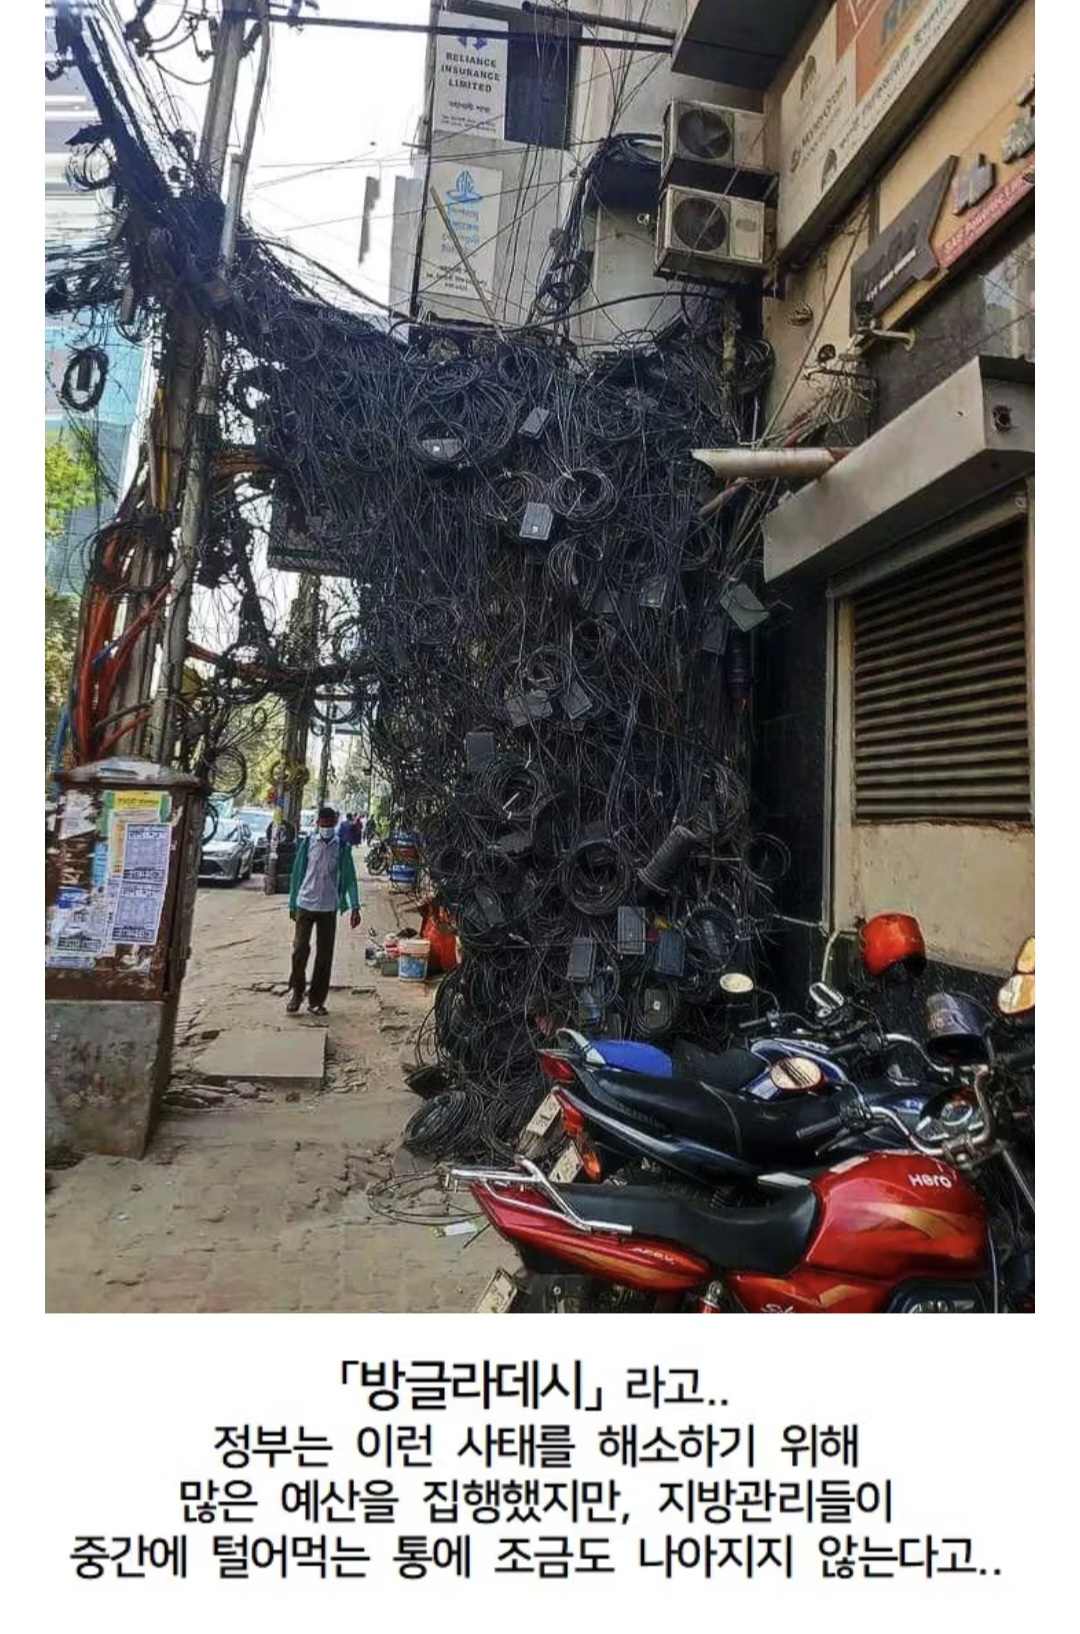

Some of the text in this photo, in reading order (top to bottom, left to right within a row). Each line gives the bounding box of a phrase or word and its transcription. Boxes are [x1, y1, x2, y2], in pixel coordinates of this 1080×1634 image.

[445, 51, 497, 68] RELIANCE
[441, 64, 500, 81] INSURANCE
[448, 79, 492, 93] LIMITED
[907, 1173, 953, 1189] Hero
